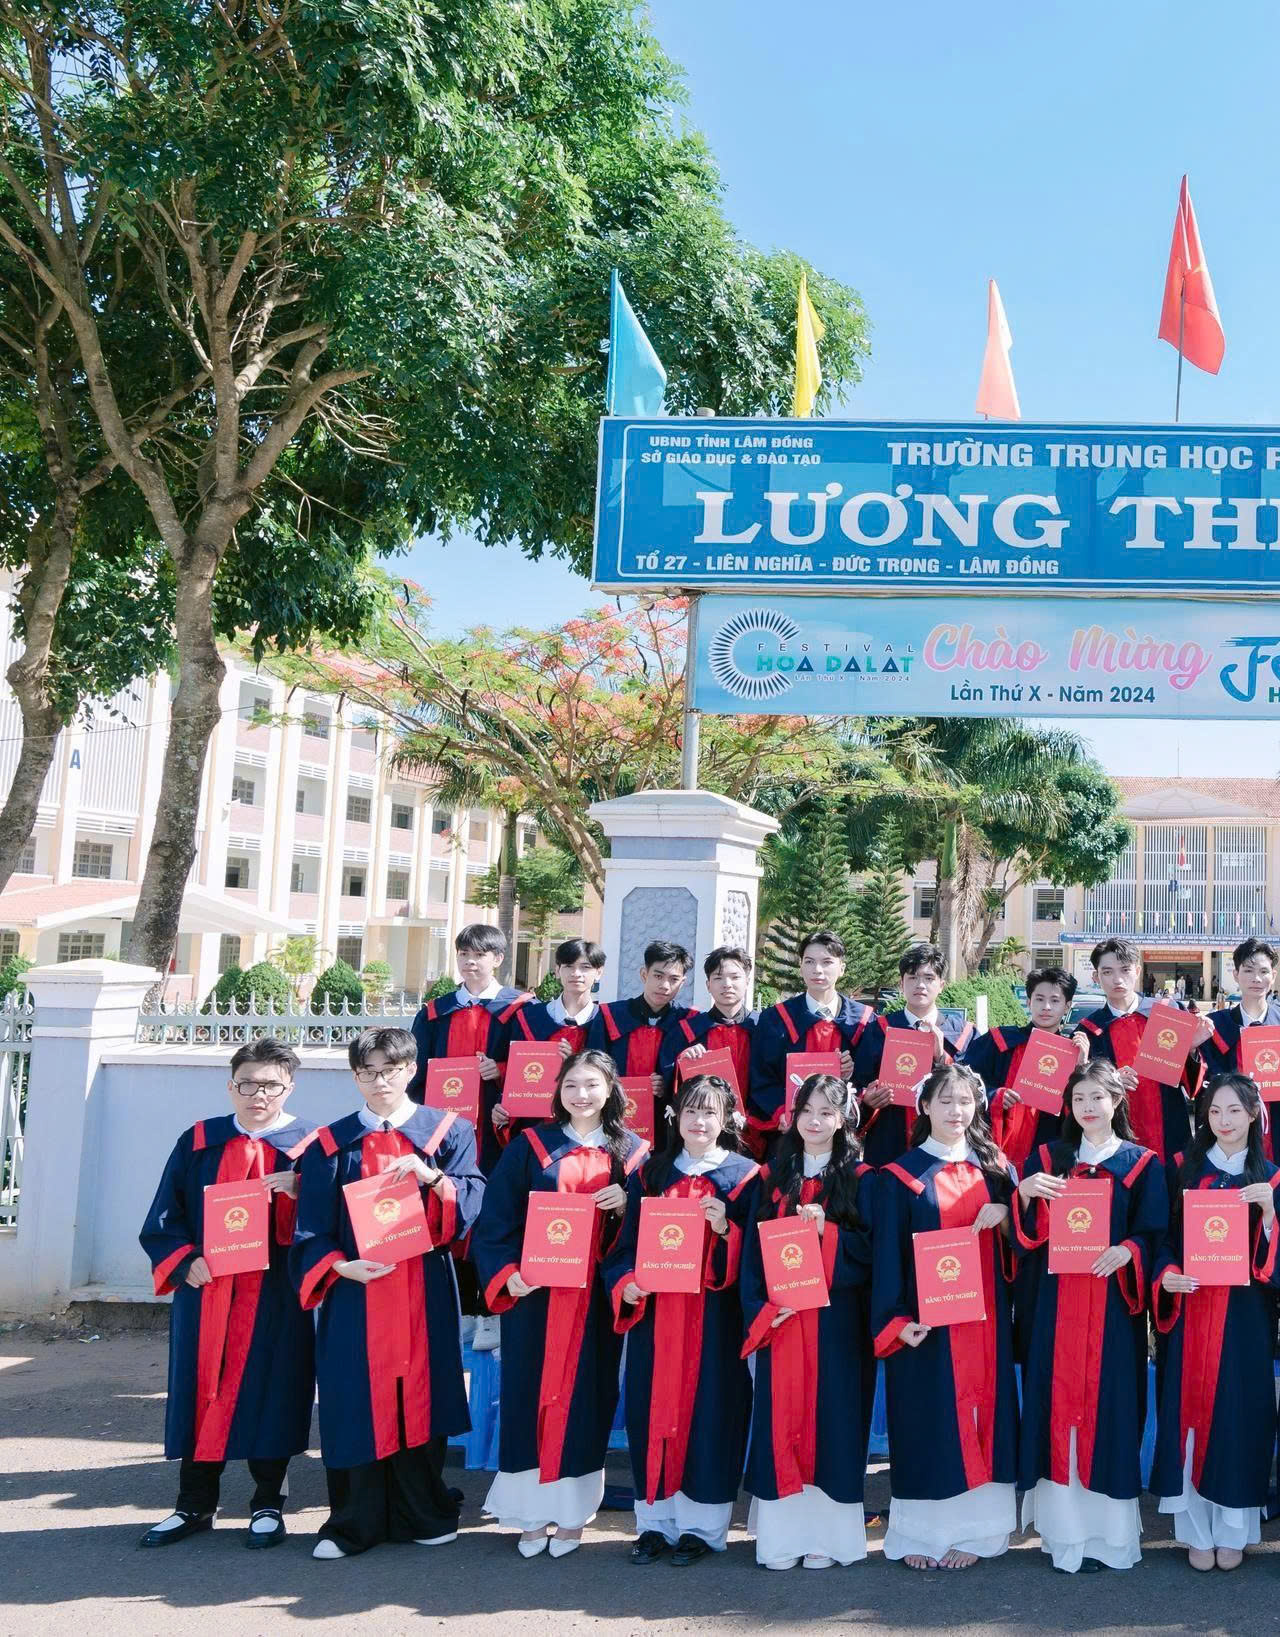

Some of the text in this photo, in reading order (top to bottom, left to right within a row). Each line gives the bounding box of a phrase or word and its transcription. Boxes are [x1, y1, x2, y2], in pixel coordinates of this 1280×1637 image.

[649, 436, 691, 448] UBND
[695, 433, 730, 448] TỈNH
[735, 435, 767, 448] LÂM
[641, 450, 821, 466] SỞ GIÁO DỤC & ĐÀO TẠO
[887, 437, 1033, 468] TRƯỜNG
[1045, 443, 1168, 469] TRUNG
[1179, 445, 1253, 474] HỌC
[694, 482, 1071, 549] LƯƠNG
[635, 550, 660, 571] TỔ
[663, 555, 688, 571] 27
[706, 553, 750, 572] LIÊN
[754, 553, 814, 572] NGHĨA
[832, 553, 872, 573] ĐỨC
[878, 557, 940, 576] TRỌNG
[959, 556, 1003, 575] LÂM
[1006, 554, 1060, 576] ĐỒNG
[758, 643, 915, 653] FESTIVAL
[923, 623, 1213, 691] Chào Mừng
[756, 655, 815, 673] HOA
[950, 680, 983, 702] Lần
[989, 681, 1023, 702] Thứ
[1028, 686, 1042, 702] X
[1060, 685, 1104, 703] Năm
[1110, 686, 1156, 704] 2024
[70, 749, 81, 770] A
